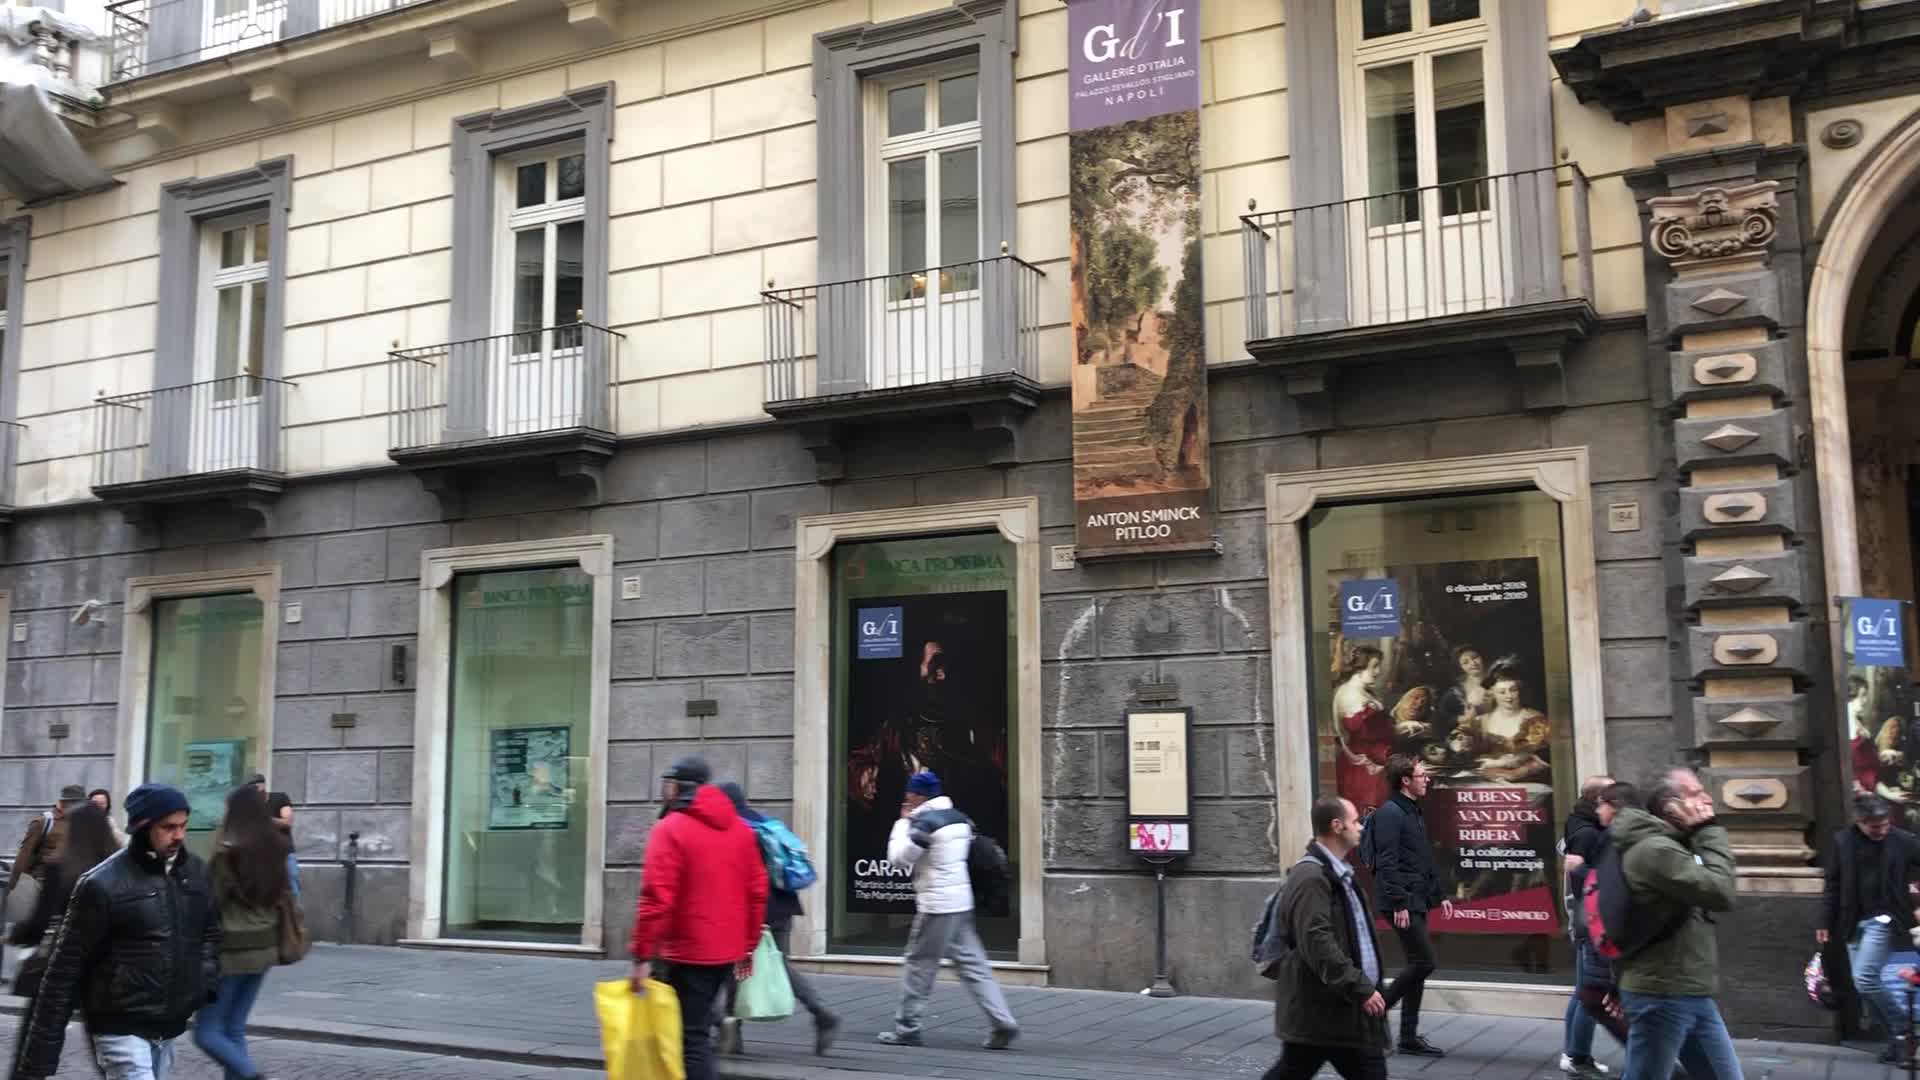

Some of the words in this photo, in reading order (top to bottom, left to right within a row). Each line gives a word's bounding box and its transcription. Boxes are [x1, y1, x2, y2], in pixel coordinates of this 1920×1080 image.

[1083, 66, 1136, 84] GALLERIE
[1137, 56, 1186, 74] D'ITALIA
[1075, 86, 1111, 98] PALAZZO
[1105, 87, 1164, 105] NAPOLI
[1087, 511, 1139, 528] ANTON
[1142, 506, 1200, 523] SMINCK
[1115, 524, 1171, 540] PITLOO
[1445, 585, 1454, 593] 6
[1454, 583, 1502, 593] dicembre
[1464, 593, 1472, 602] 7
[1472, 592, 1502, 603] aprile
[1457, 791, 1522, 803] RUBENS
[1457, 810, 1491, 822] VAN
[1495, 810, 1541, 822] DYCK
[1459, 829, 1520, 841] RIBERA
[1460, 847, 1475, 857] La
[1477, 847, 1536, 857] collezione
[1460, 858, 1473, 869] di
[1475, 860, 1491, 869] un
[1493, 858, 1544, 871] principe
[856, 890, 871, 899] The
[1454, 909, 1487, 919] INTESA
[1501, 910, 1550, 921] SANPAOLO
